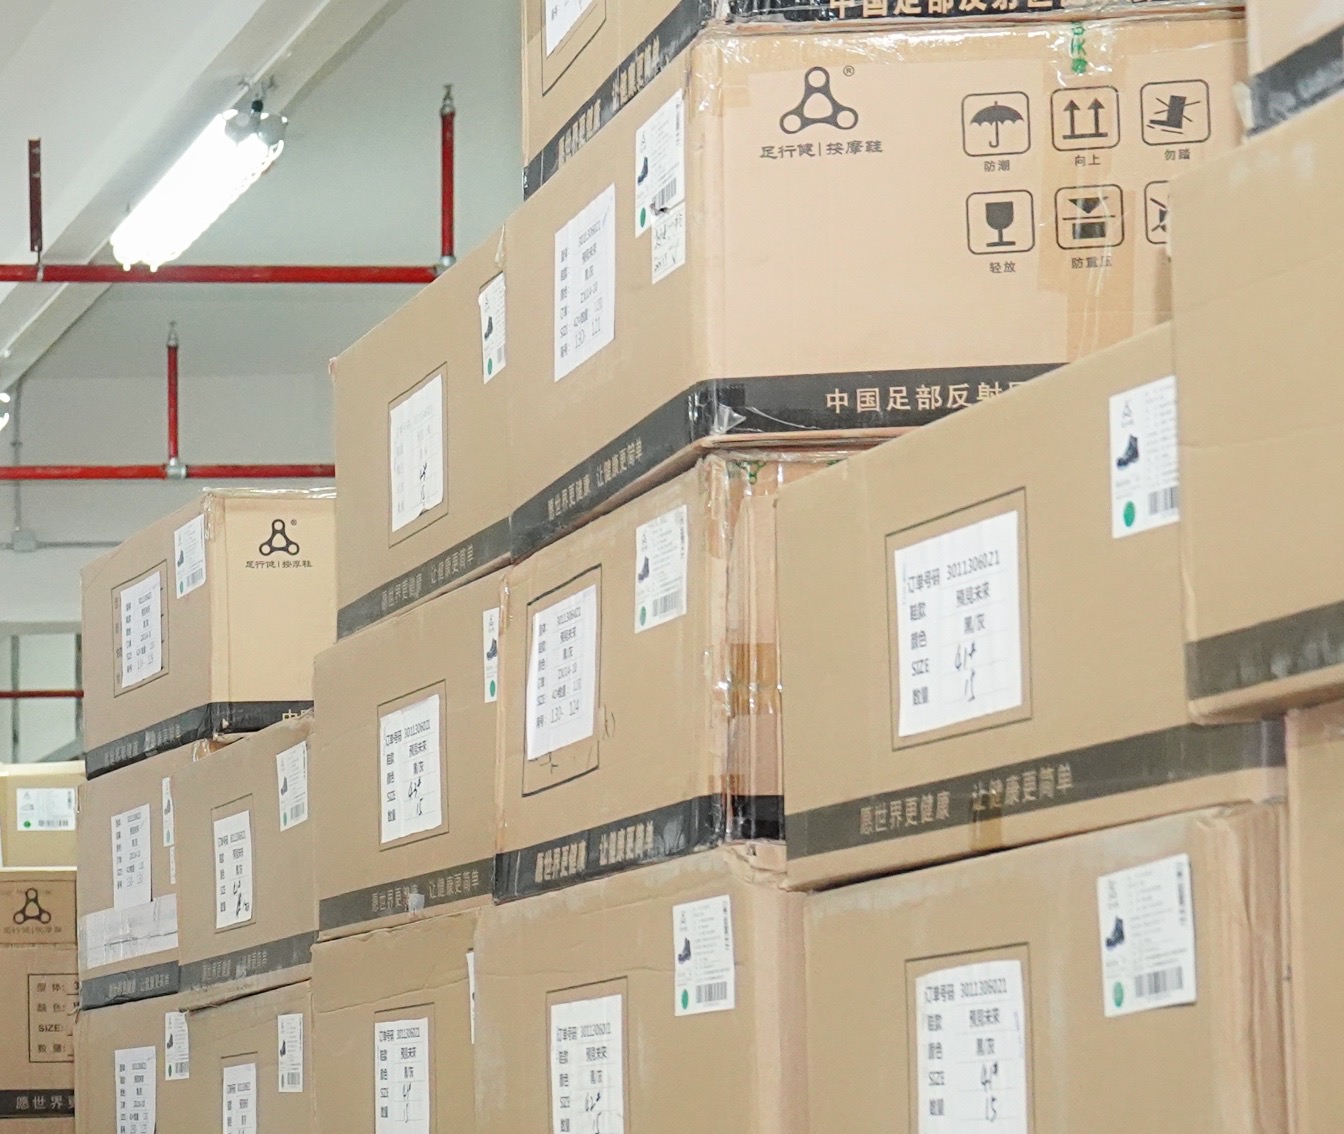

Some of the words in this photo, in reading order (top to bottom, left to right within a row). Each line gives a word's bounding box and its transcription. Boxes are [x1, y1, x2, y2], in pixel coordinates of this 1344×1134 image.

[984, 160, 1010, 172] 防潮
[1075, 155, 1100, 166] 向上
[990, 262, 1016, 274] 轻放
[826, 381, 1028, 414] 中国足部反射
